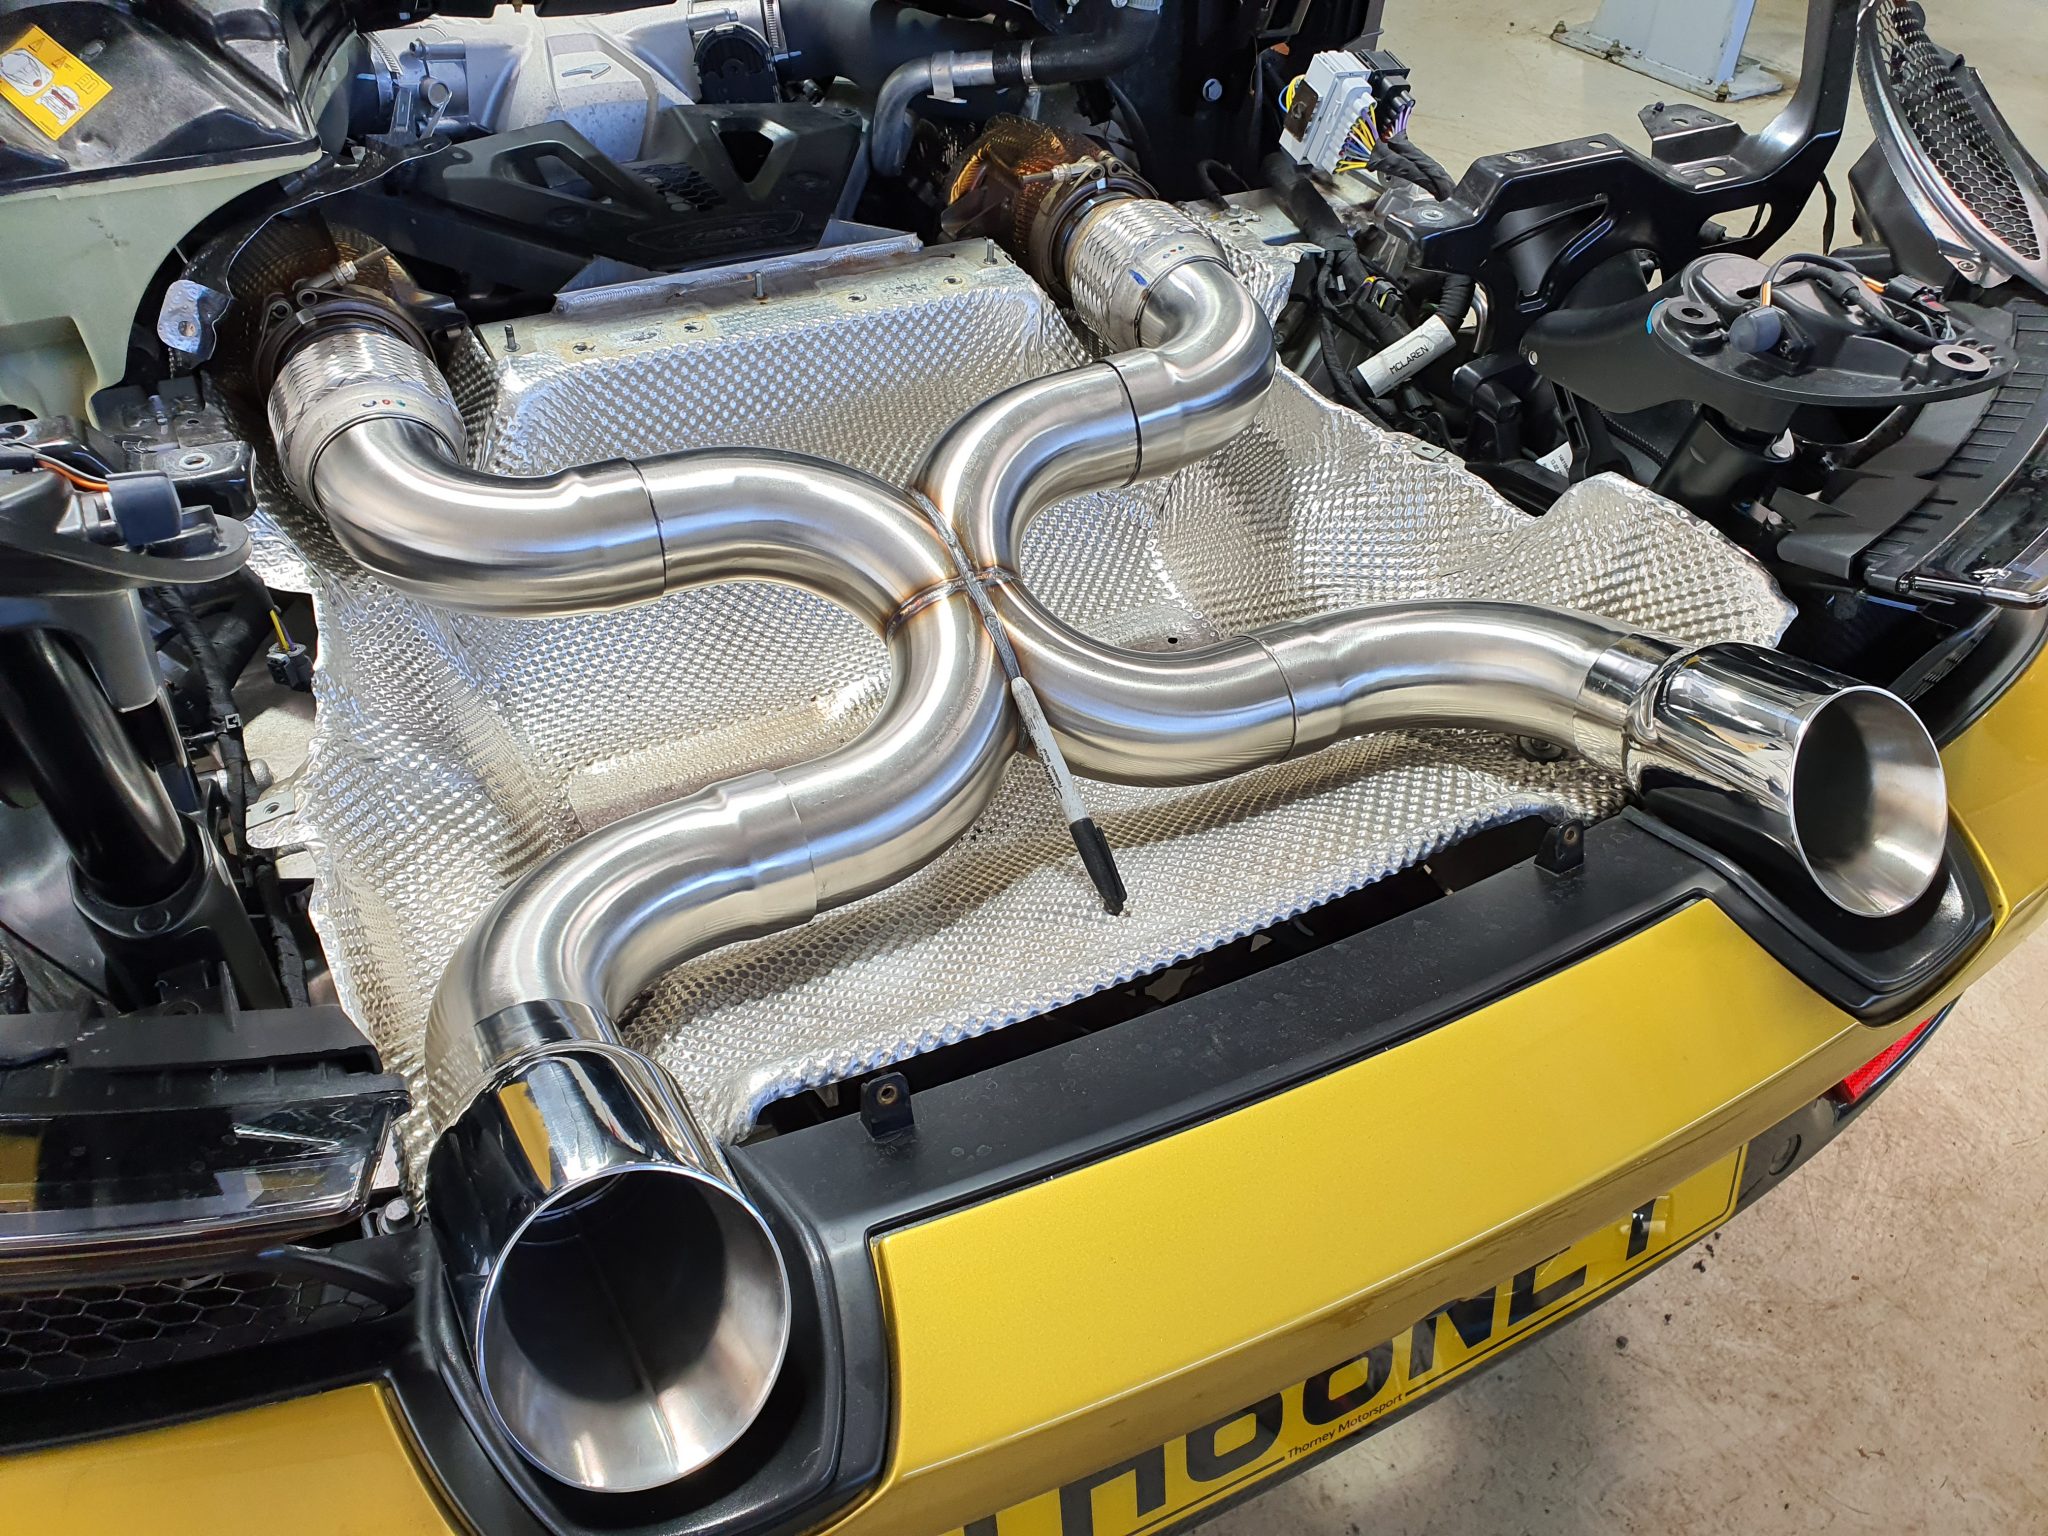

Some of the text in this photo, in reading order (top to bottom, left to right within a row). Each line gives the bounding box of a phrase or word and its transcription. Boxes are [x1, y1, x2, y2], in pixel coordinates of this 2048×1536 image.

[1389, 344, 1429, 374] MCLAREN
[1288, 1393, 1403, 1458] Thorney Motorsport
